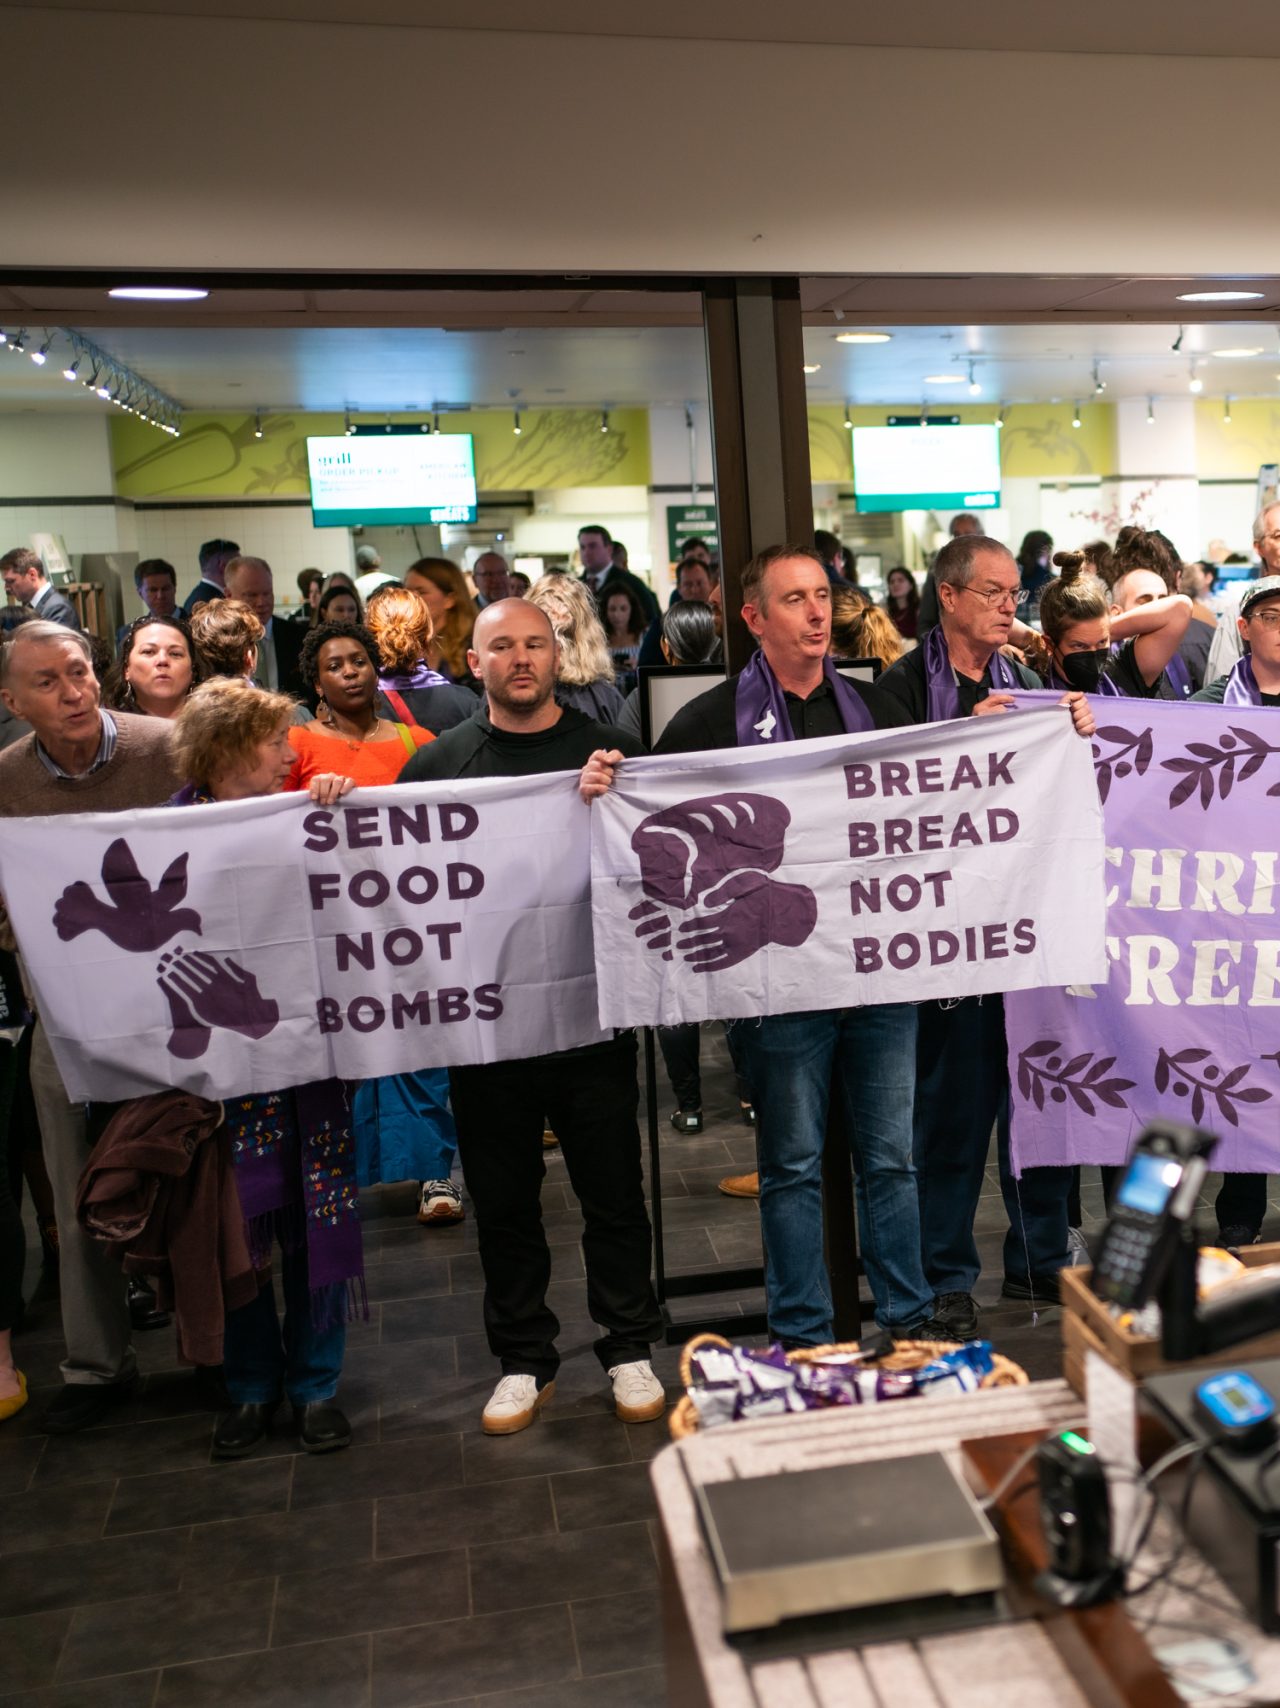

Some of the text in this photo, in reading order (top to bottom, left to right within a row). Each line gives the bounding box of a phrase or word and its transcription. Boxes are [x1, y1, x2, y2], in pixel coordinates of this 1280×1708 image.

[843, 751, 1018, 800] BREAK
[302, 802, 479, 853] SEND
[848, 808, 1020, 858] BREAD
[308, 862, 486, 911] FOOD
[850, 870, 953, 916] NOT
[335, 922, 463, 972] NOT
[852, 918, 1037, 974] BODIES
[316, 983, 504, 1035] BOMBS
